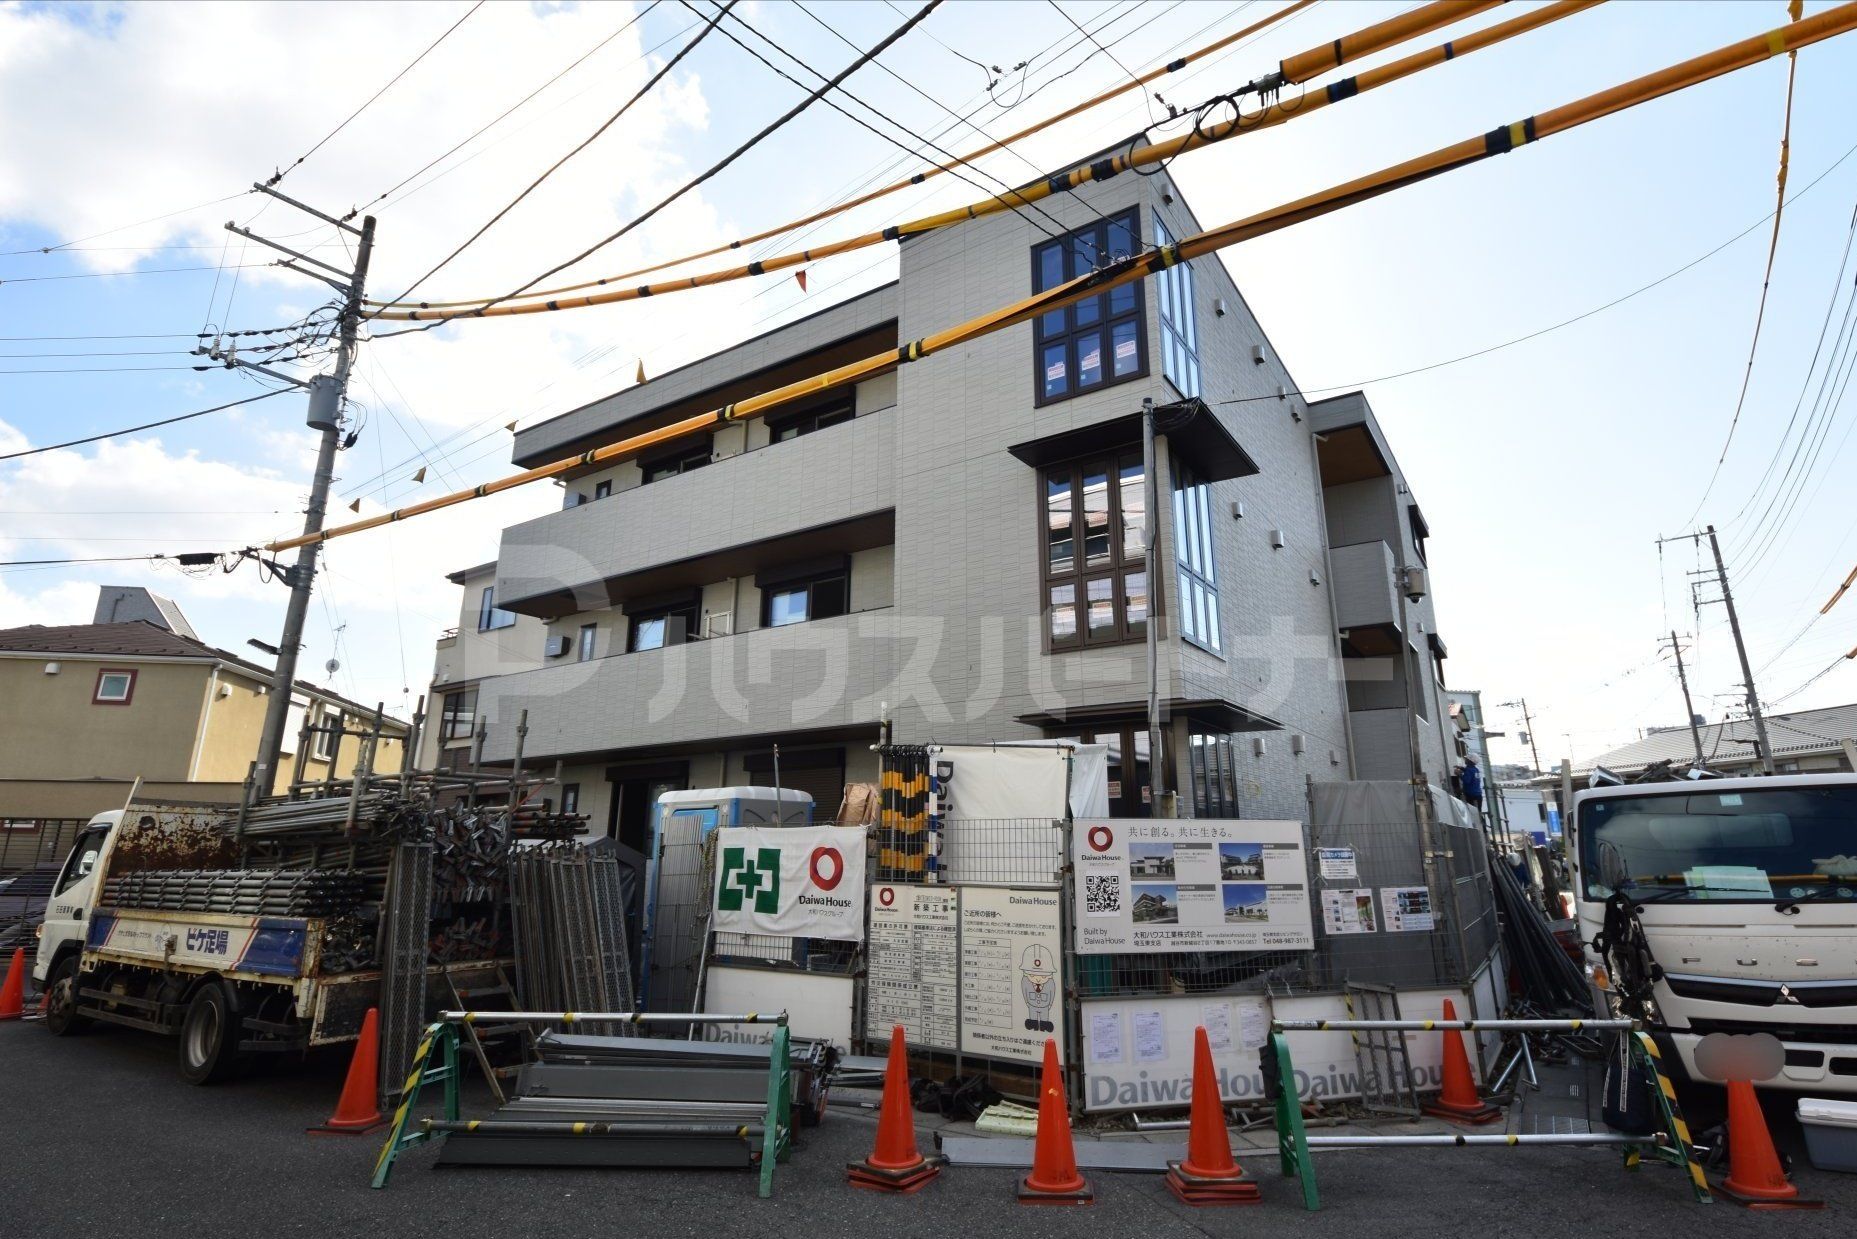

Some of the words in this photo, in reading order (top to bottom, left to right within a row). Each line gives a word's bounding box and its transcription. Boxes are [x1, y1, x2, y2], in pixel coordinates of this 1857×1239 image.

[186, 927, 229, 955] ビケ足場
[1133, 931, 1203, 939] 大和ハウス工業株式会社
